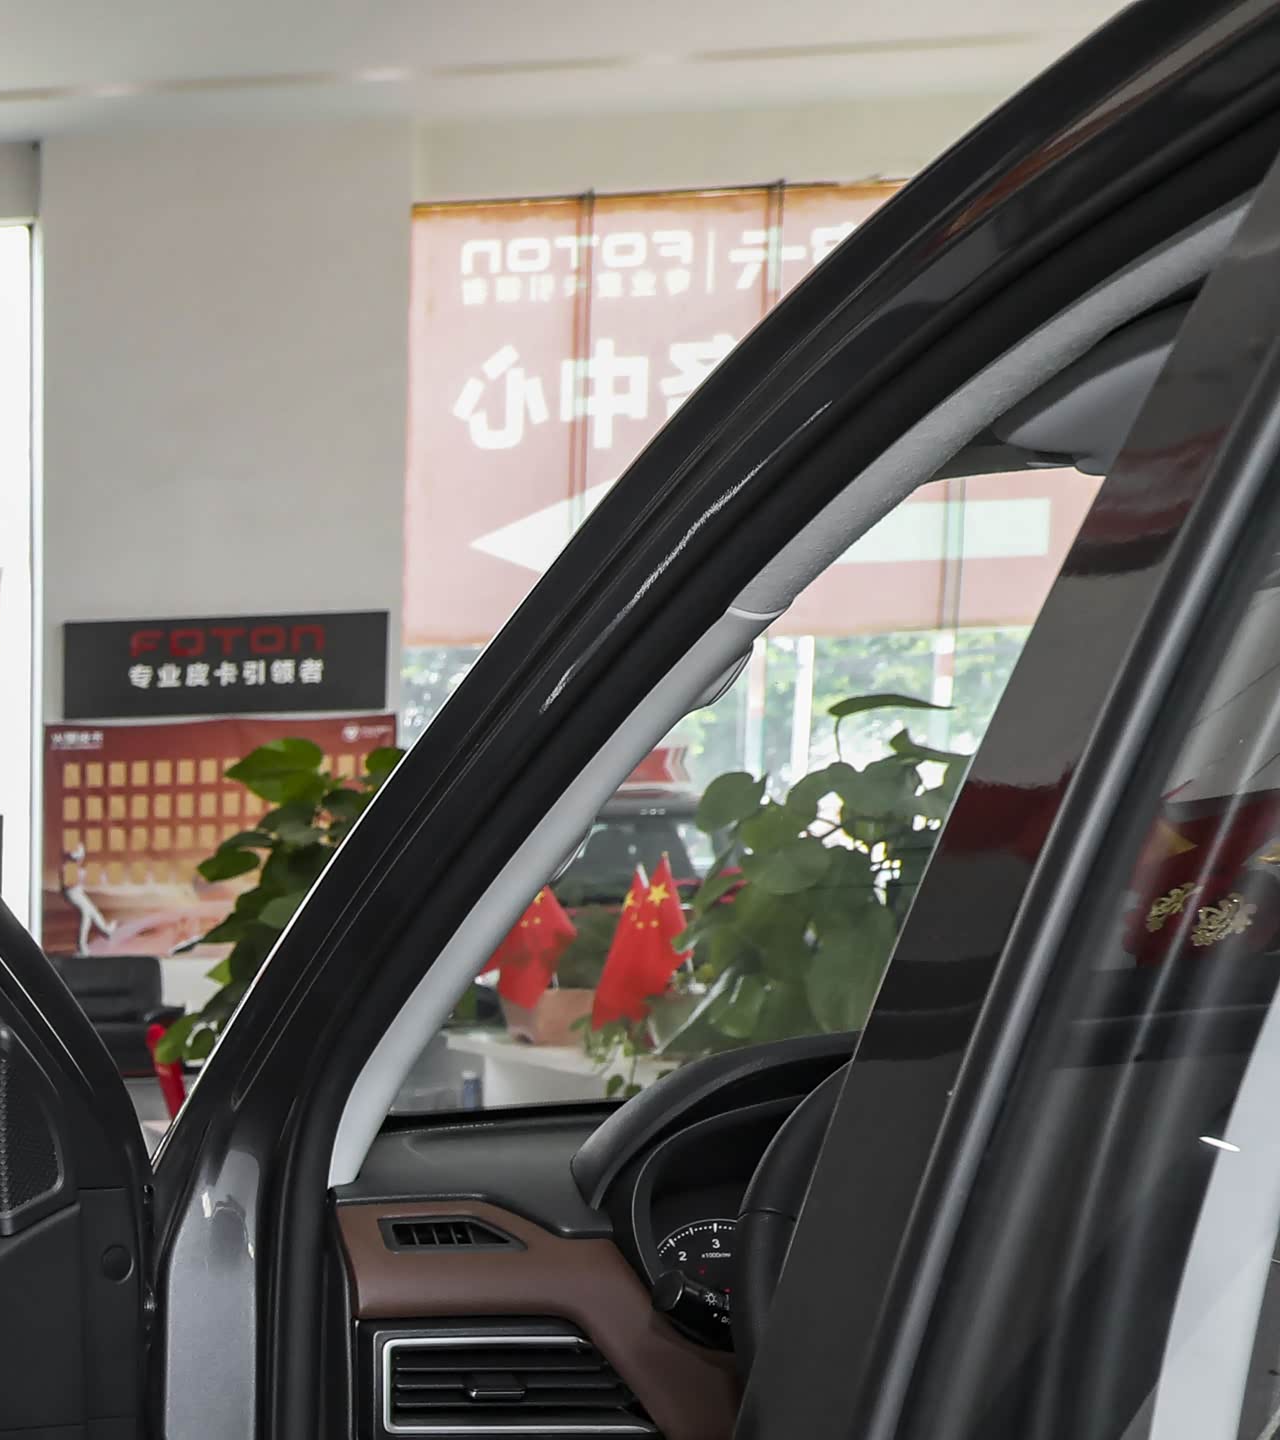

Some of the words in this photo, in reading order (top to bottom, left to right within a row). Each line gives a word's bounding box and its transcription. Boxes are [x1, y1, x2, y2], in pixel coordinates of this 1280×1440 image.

[129, 624, 325, 657] FOTON
[128, 658, 324, 689] 专业皮卡引领者
[711, 1238, 721, 1249] 3
[678, 1251, 688, 1261] 2
